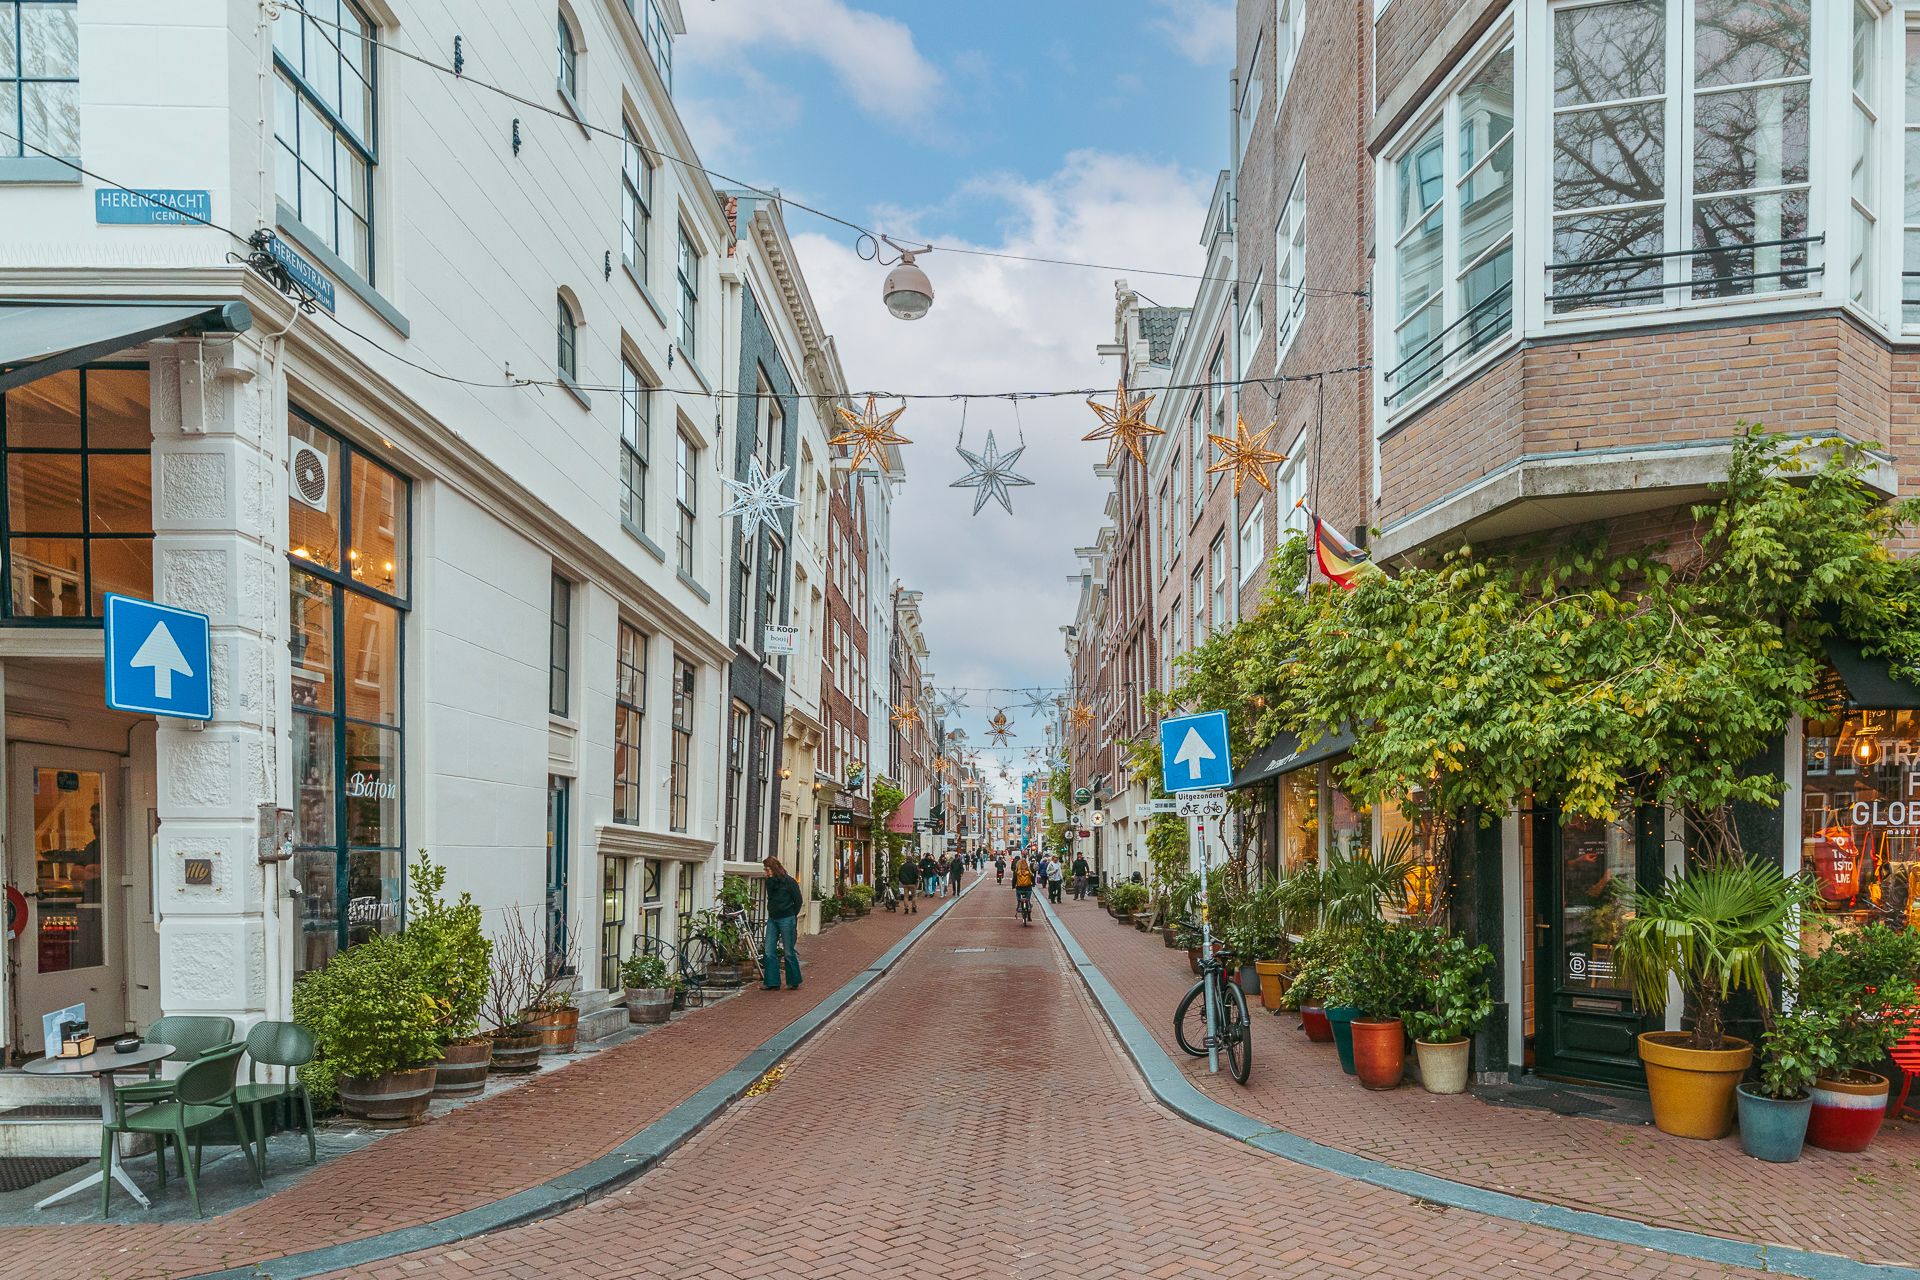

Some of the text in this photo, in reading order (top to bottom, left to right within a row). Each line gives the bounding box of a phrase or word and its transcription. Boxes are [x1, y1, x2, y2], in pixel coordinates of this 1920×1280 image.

[101, 193, 205, 208] HERENGRACHT
[152, 211, 206, 221] (CENTRUM)
[273, 239, 331, 295] HERENSTRAAT
[1178, 792, 1224, 801] Uitgezonderd
[1833, 861, 1854, 871] IS TO
[186, 862, 209, 881] illy
[1835, 873, 1851, 883] LIVE
